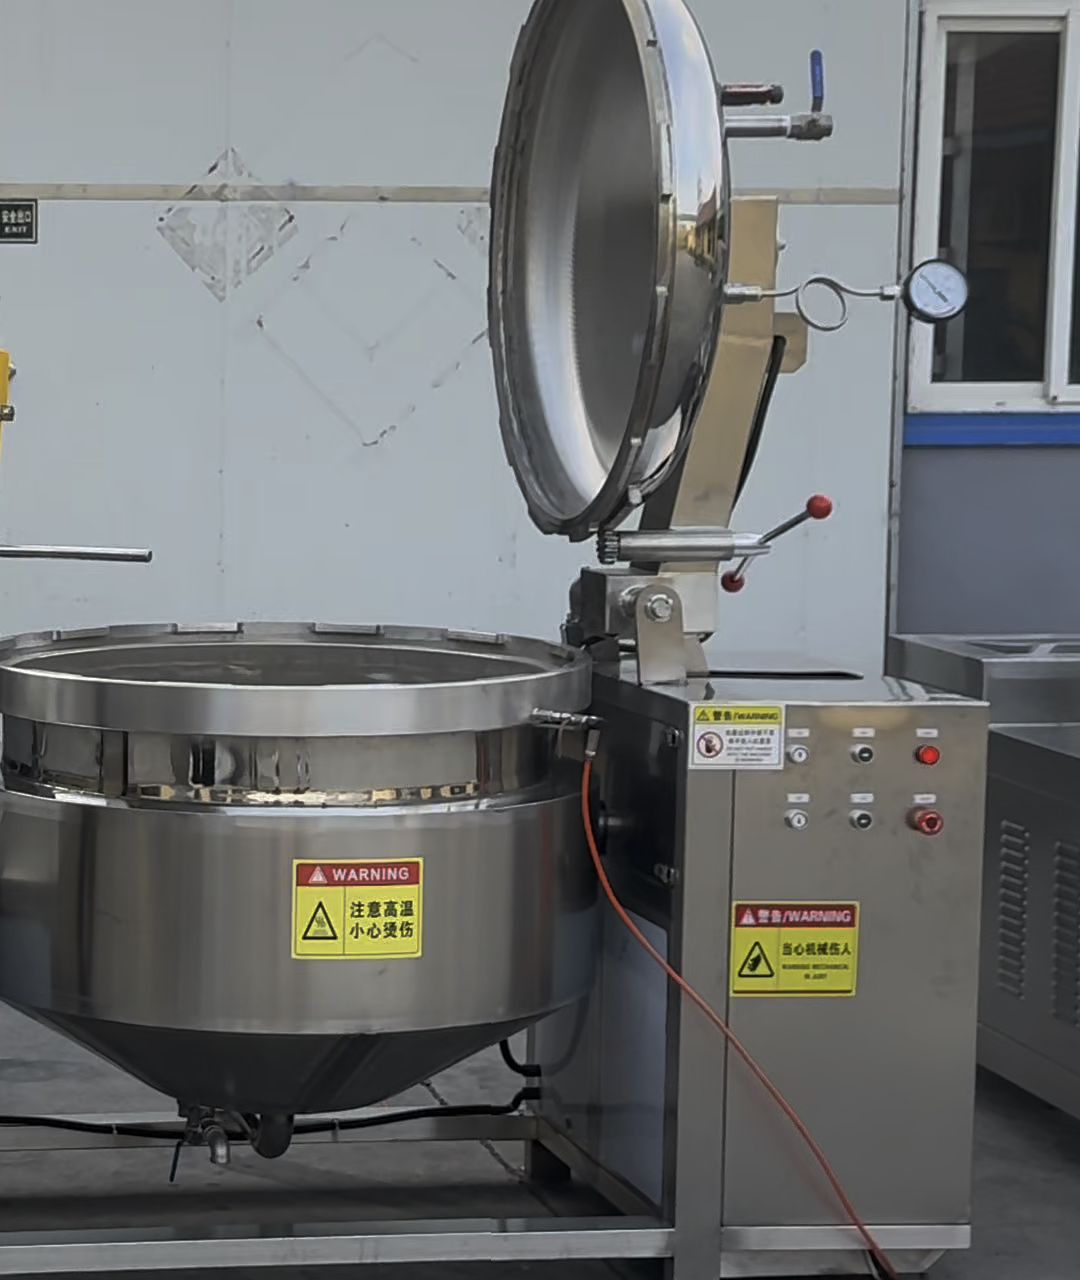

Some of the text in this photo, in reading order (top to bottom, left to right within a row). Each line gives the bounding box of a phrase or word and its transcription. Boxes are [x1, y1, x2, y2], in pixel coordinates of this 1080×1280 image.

[332, 867, 410, 882] WARNING
[349, 900, 414, 918] 注意高温
[349, 921, 414, 939] 小心烫伤
[782, 942, 852, 956] 当心机械伤人
